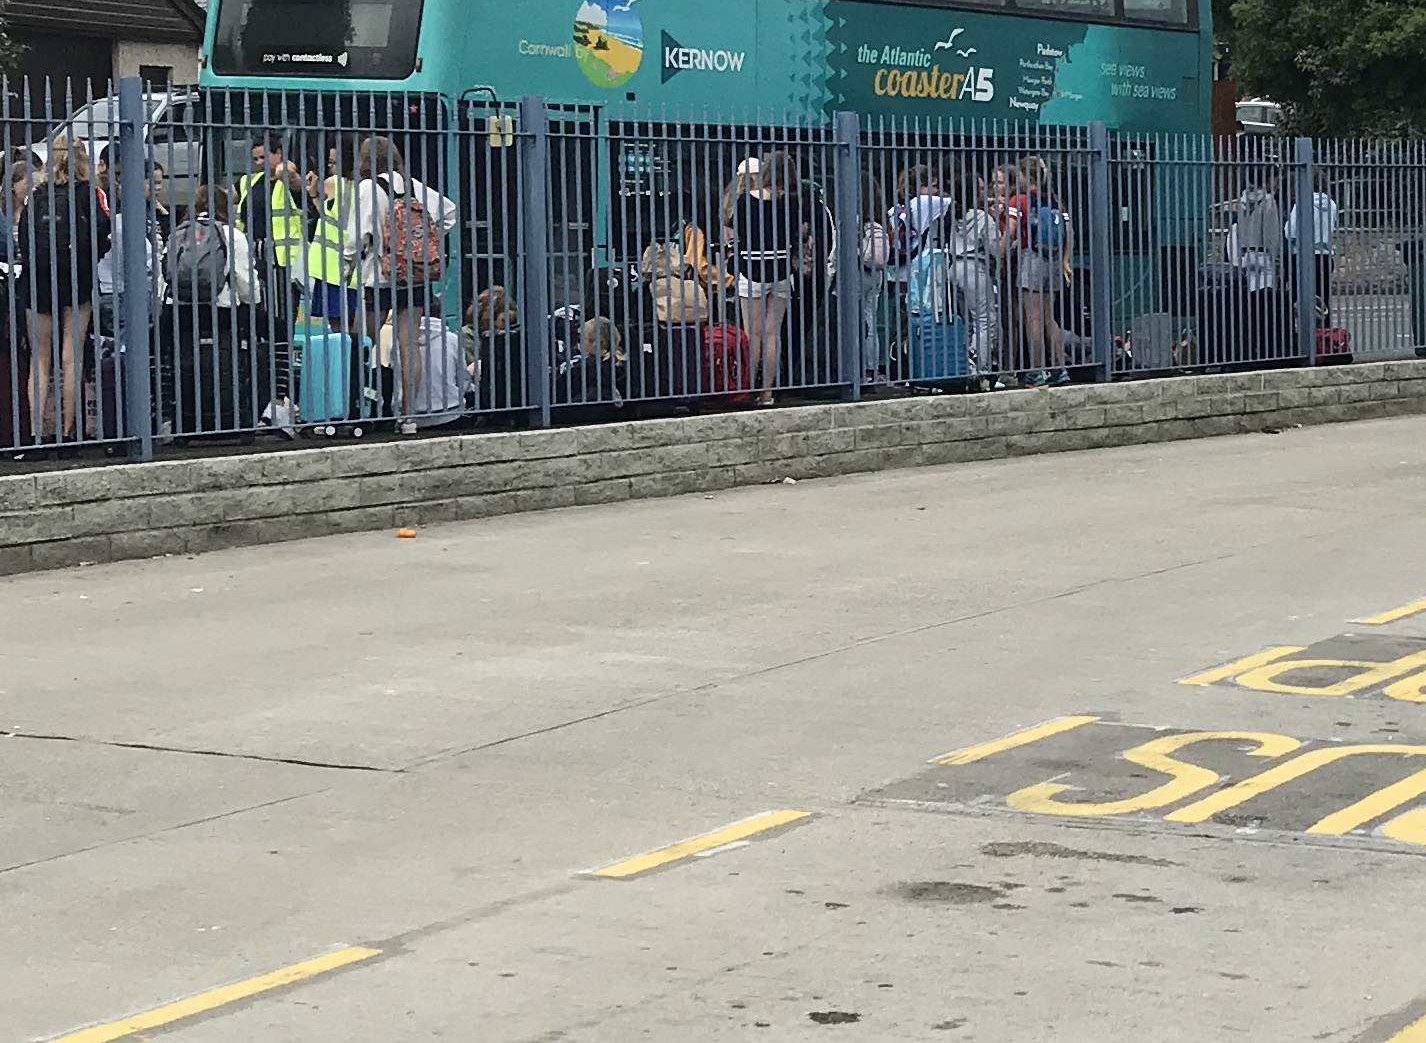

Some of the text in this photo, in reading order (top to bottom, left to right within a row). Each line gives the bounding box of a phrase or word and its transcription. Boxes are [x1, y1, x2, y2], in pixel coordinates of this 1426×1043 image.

[518, 39, 571, 58] Cornwall
[857, 43, 932, 68] the Atlantic
[665, 46, 745, 72] KERNOW
[1100, 62, 1146, 79] sea views
[1111, 81, 1178, 101] with sea views
